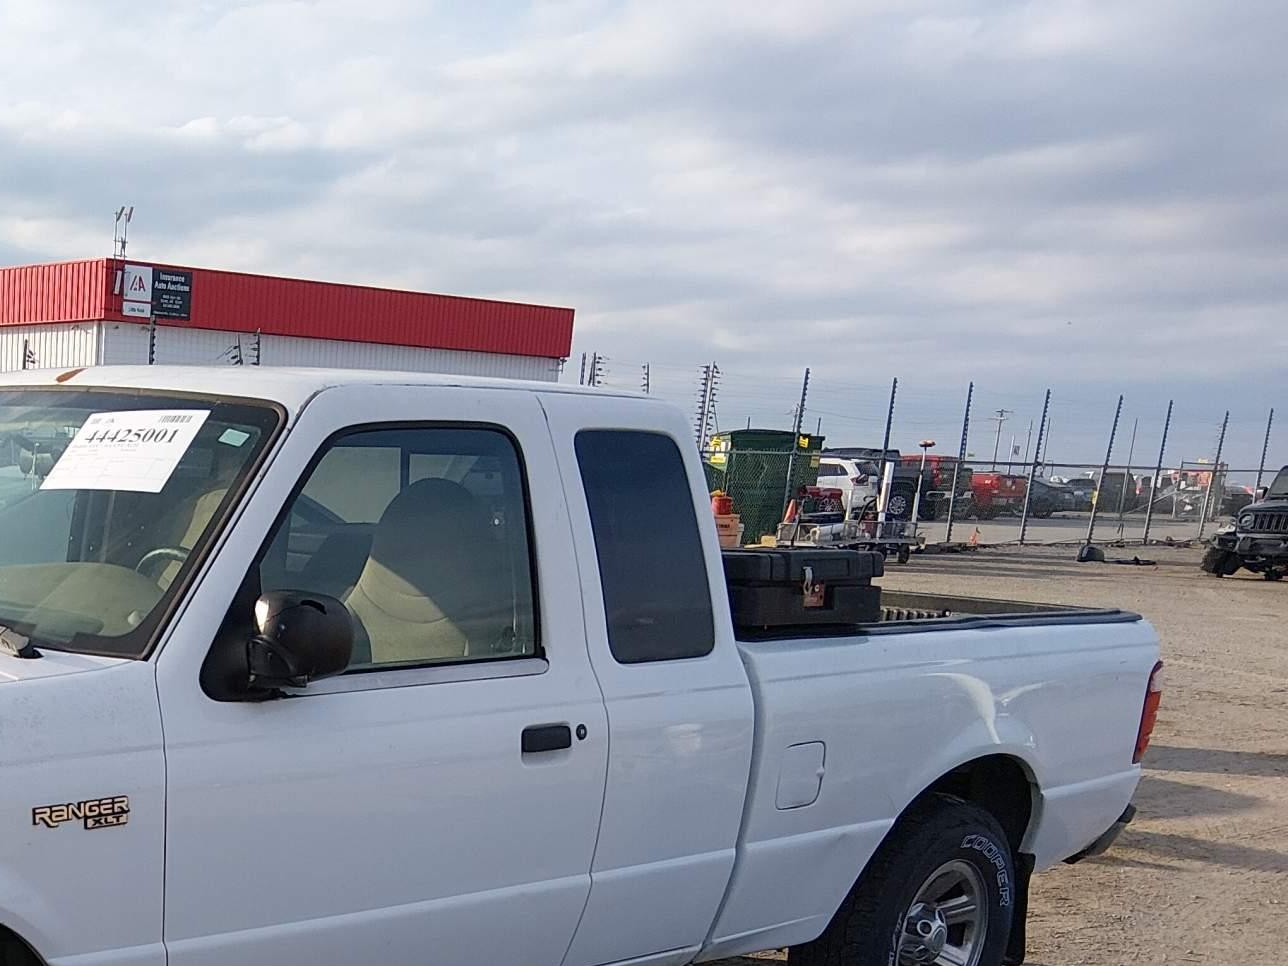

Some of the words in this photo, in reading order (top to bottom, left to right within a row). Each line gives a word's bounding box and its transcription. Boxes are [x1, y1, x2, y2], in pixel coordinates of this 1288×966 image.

[159, 272, 185, 282] Insurance
[154, 281, 166, 289] Auto
[167, 282, 190, 292] Auctions
[85, 428, 180, 443] 44425001
[32, 795, 130, 828] RANGER
[90, 814, 125, 828] XLT
[961, 834, 1009, 906] COOPER
